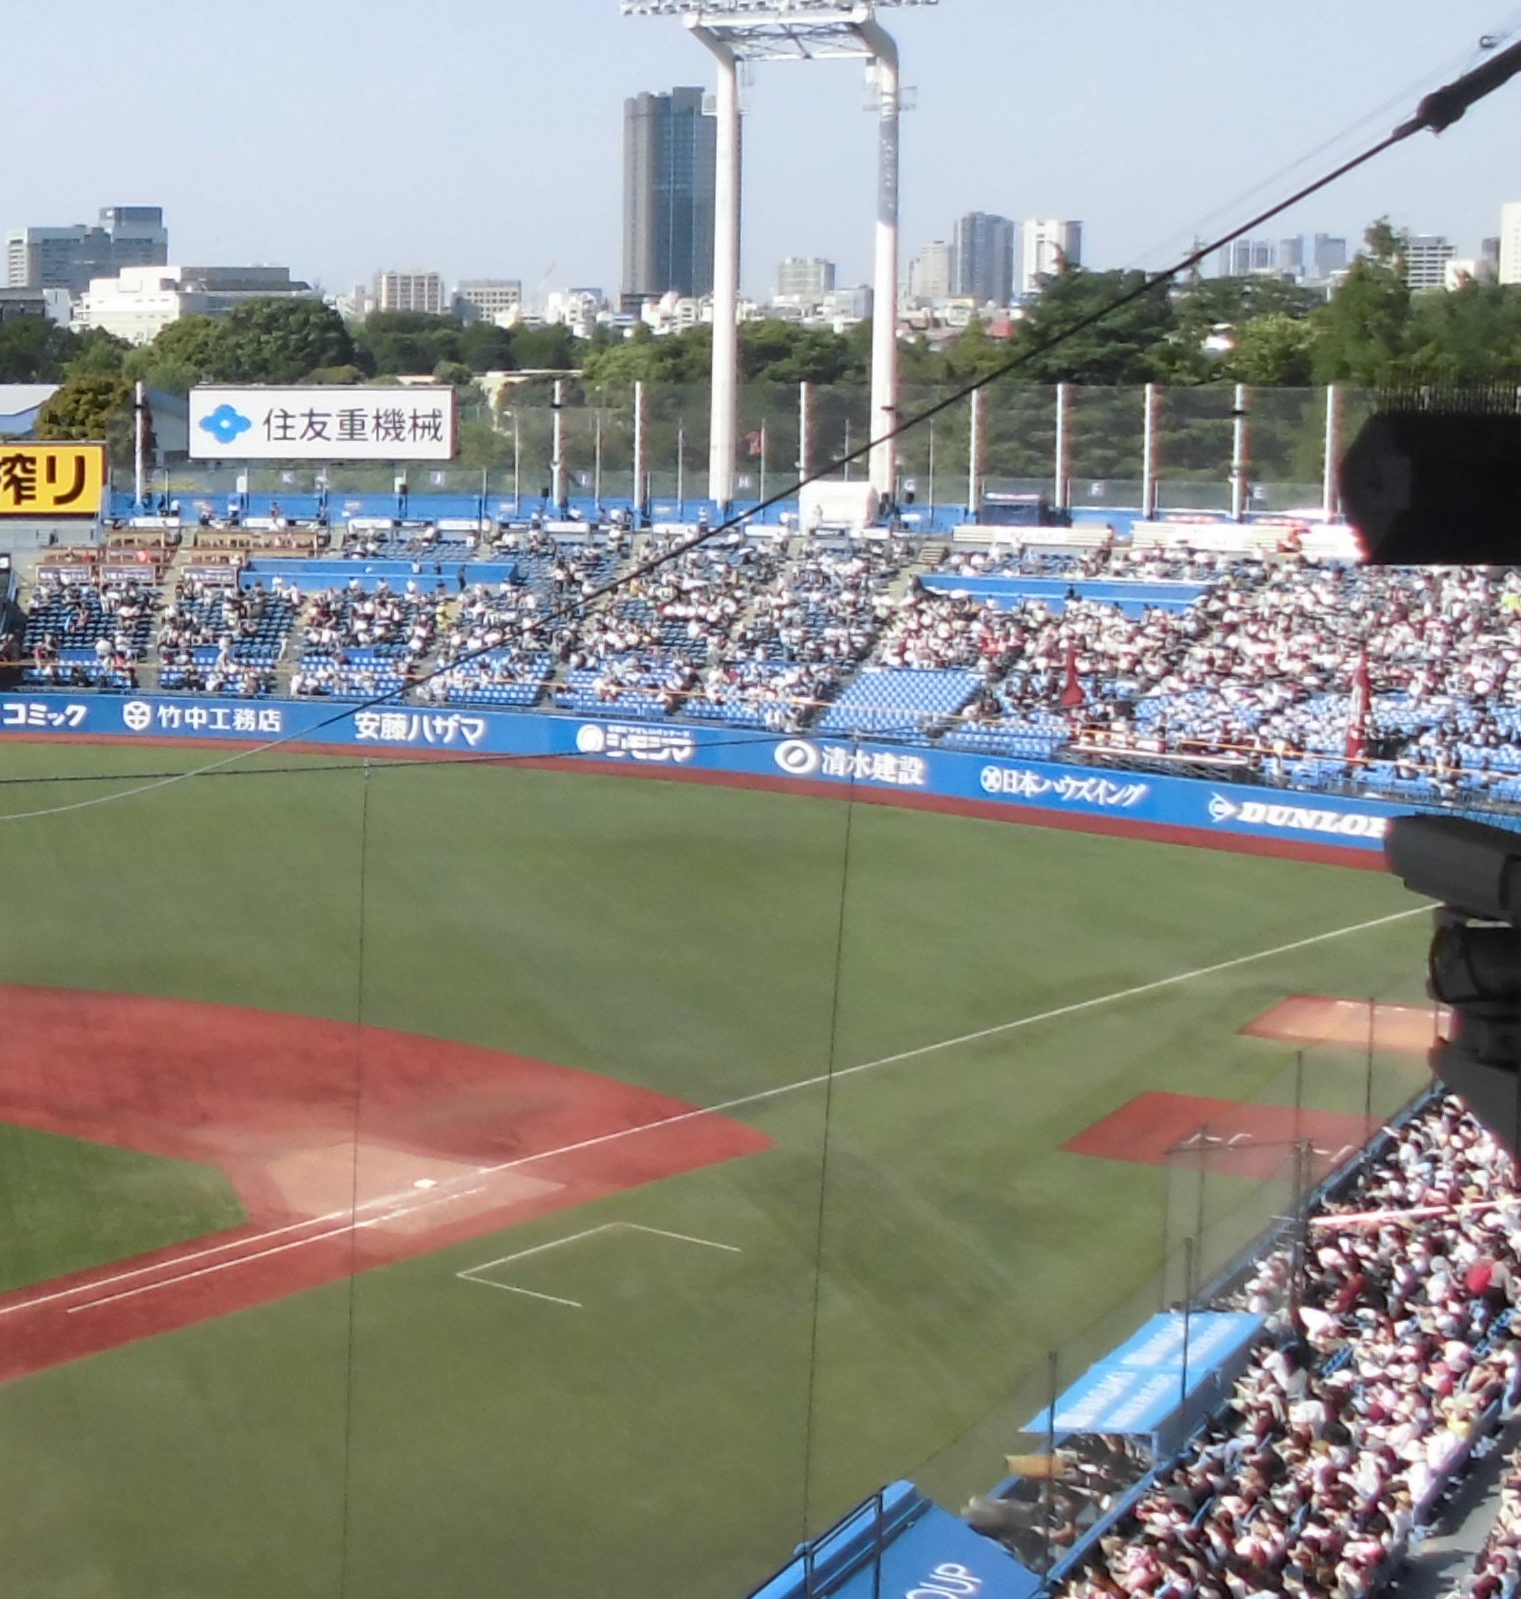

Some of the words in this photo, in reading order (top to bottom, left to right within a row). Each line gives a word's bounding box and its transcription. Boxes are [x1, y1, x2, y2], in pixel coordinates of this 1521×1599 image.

[262, 408, 443, 442] 住友重機械
[157, 705, 282, 732] 竹中工務店
[354, 711, 487, 746] 安藤ハザマ
[821, 744, 926, 786] 清水建設
[1001, 767, 1148, 809] 日本ハウズイング
